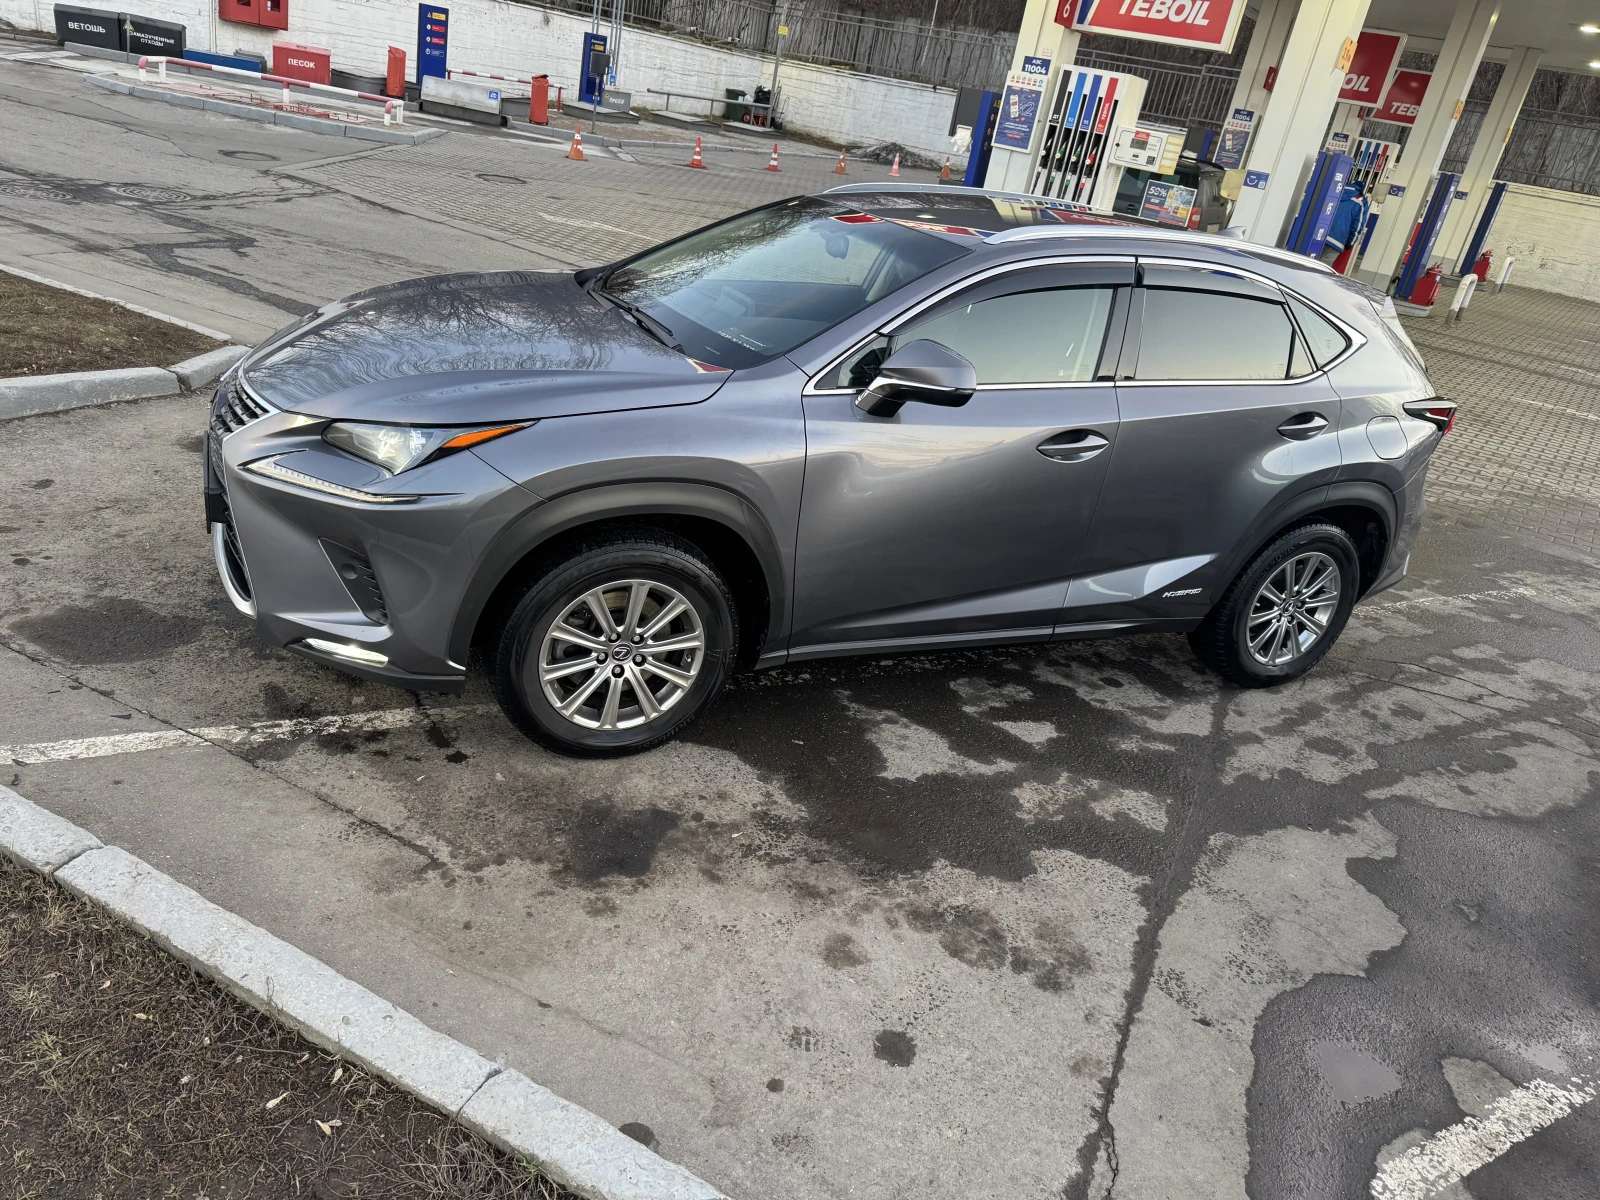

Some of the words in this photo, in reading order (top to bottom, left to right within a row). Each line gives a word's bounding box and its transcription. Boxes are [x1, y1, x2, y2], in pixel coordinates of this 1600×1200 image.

[1062, 0, 1071, 18] 6
[68, 21, 106, 34] ВЕТОШЬ
[129, 30, 175, 45] ЗАМАЗУЧЕННЫЕ
[140, 38, 164, 47] ОТХОДЫ
[287, 58, 316, 69] ПЕСОК
[1024, 64, 1046, 74] 11004
[1148, 186, 1168, 197] 50%
